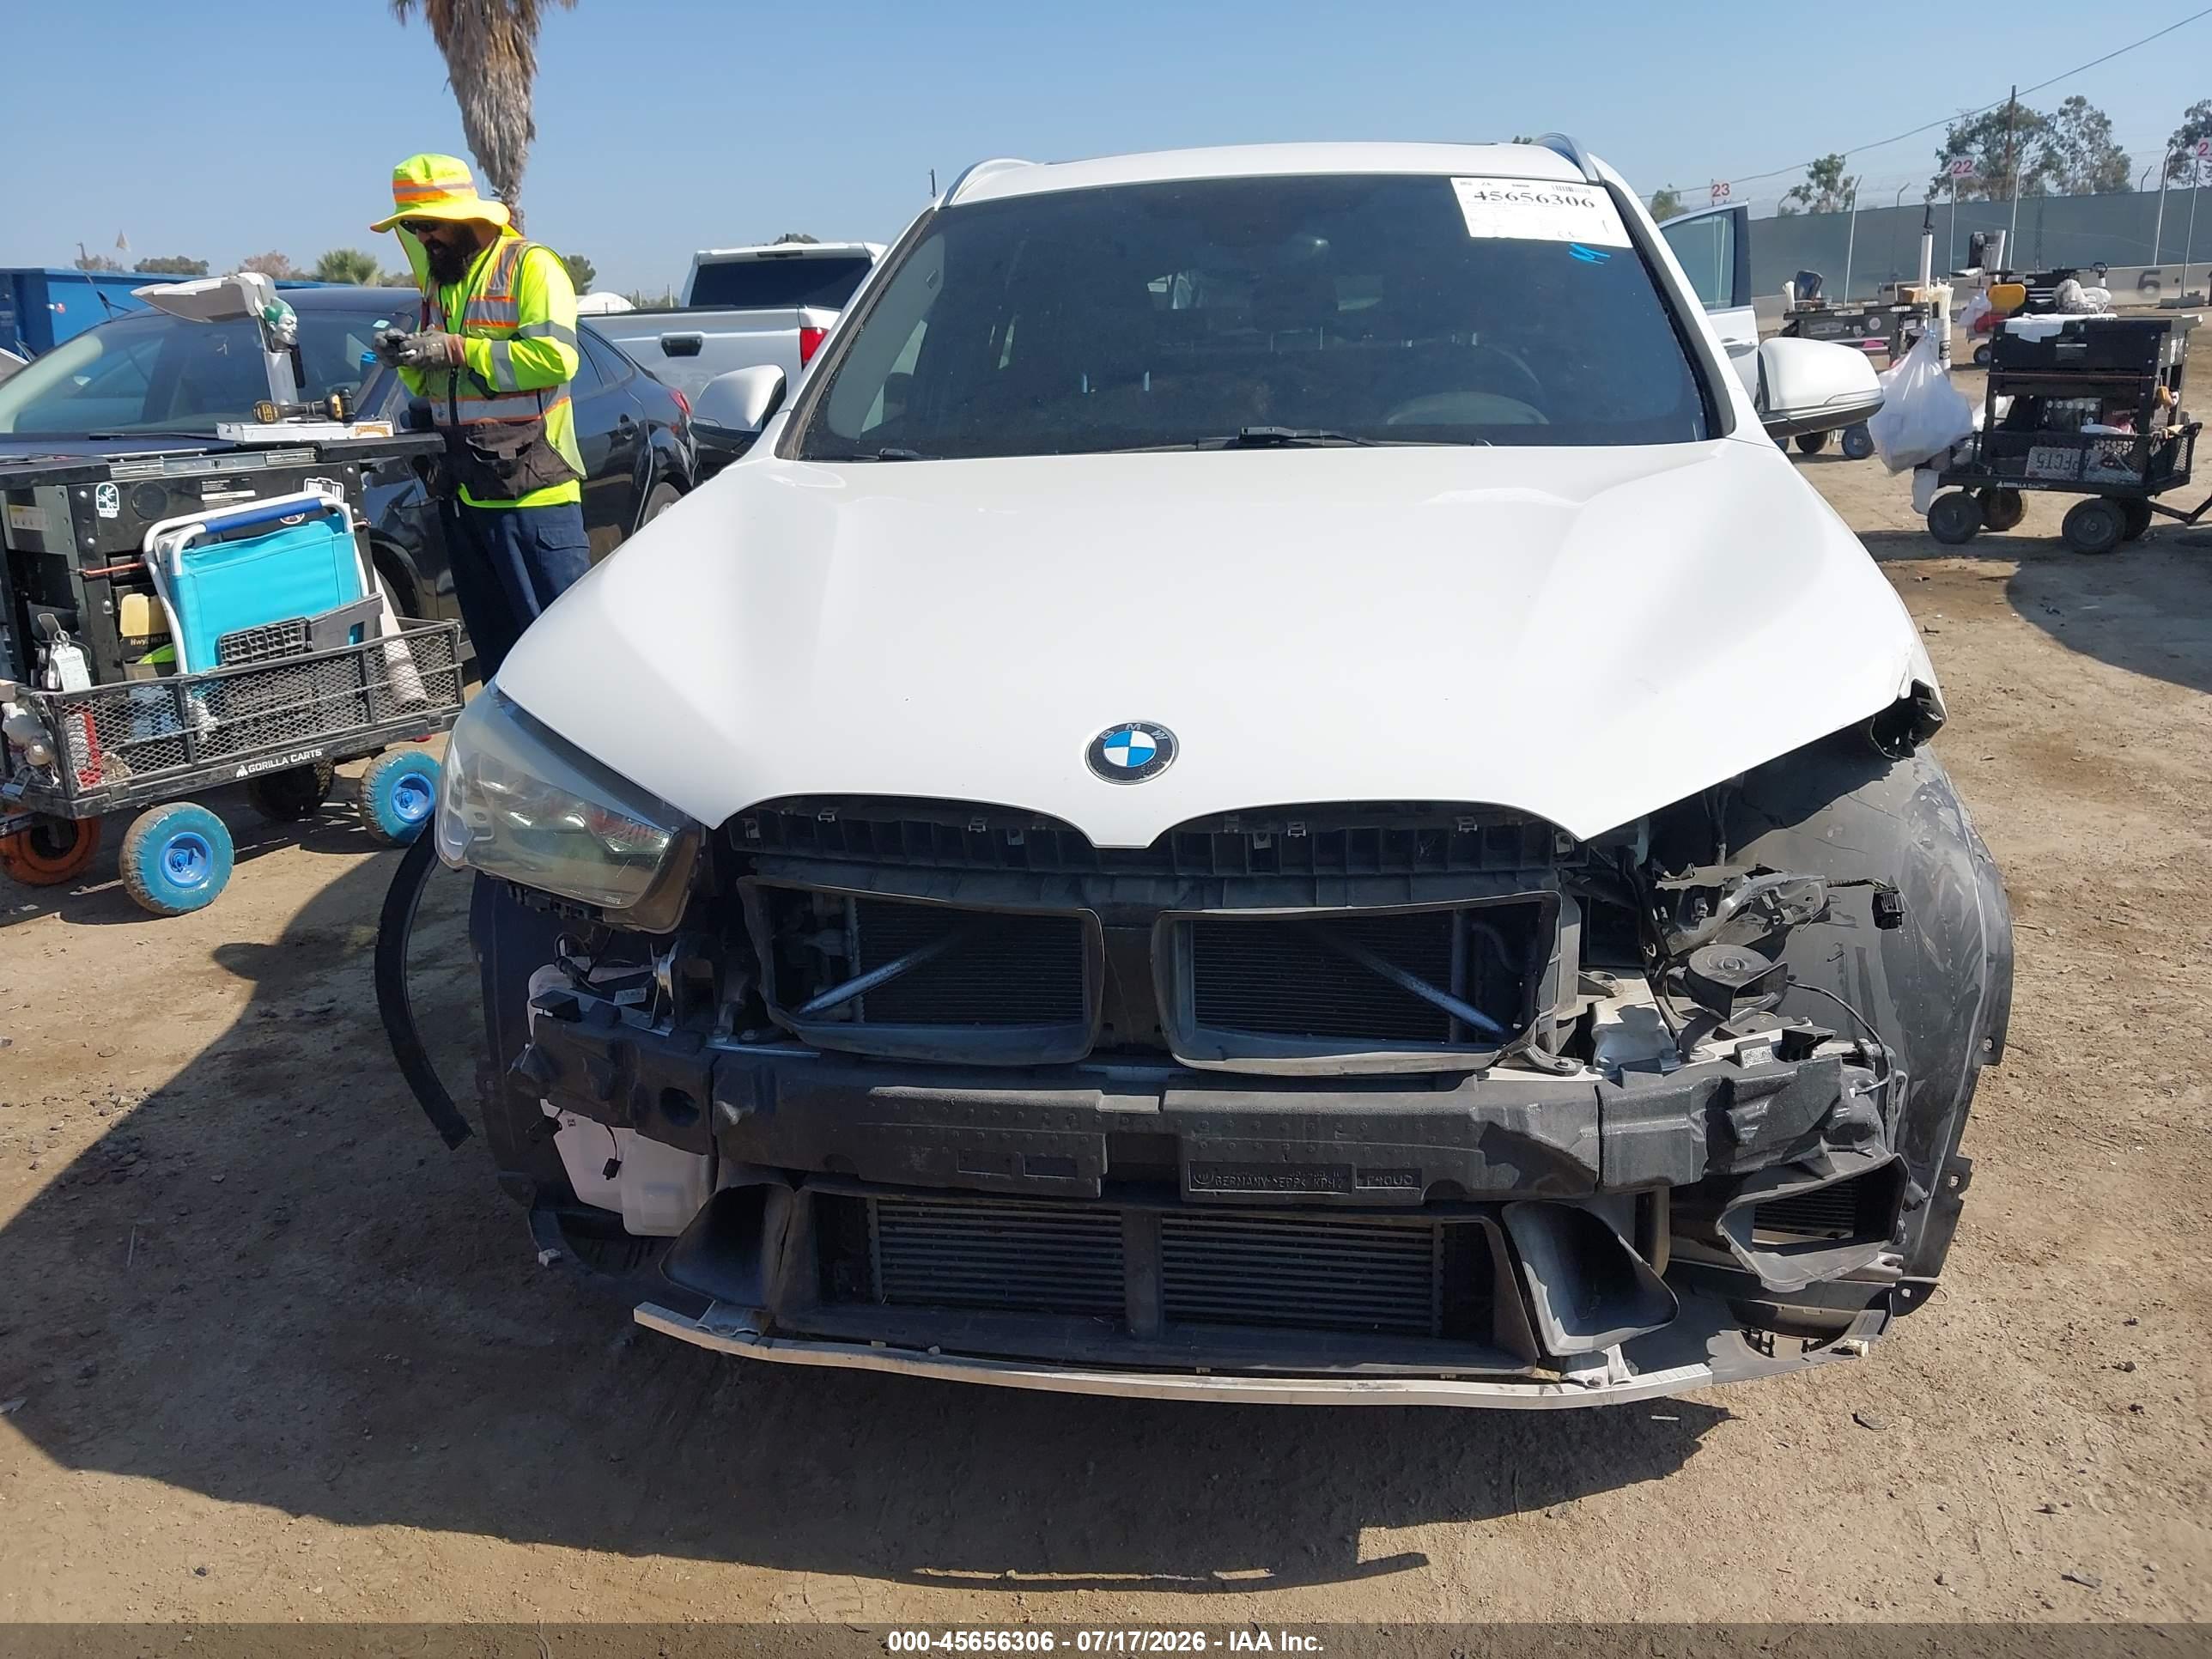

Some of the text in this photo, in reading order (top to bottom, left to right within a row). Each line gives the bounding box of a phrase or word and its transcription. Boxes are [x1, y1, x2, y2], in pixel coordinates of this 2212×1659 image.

[2198, 142, 2212, 156] 2
[1954, 160, 1972, 174] 22
[1474, 189, 1595, 209] 45656306
[1711, 183, 1730, 198] 23
[2137, 269, 2161, 300] 6
[1098, 723, 1169, 740] BMW
[247, 748, 323, 774] GORILLA CARTS
